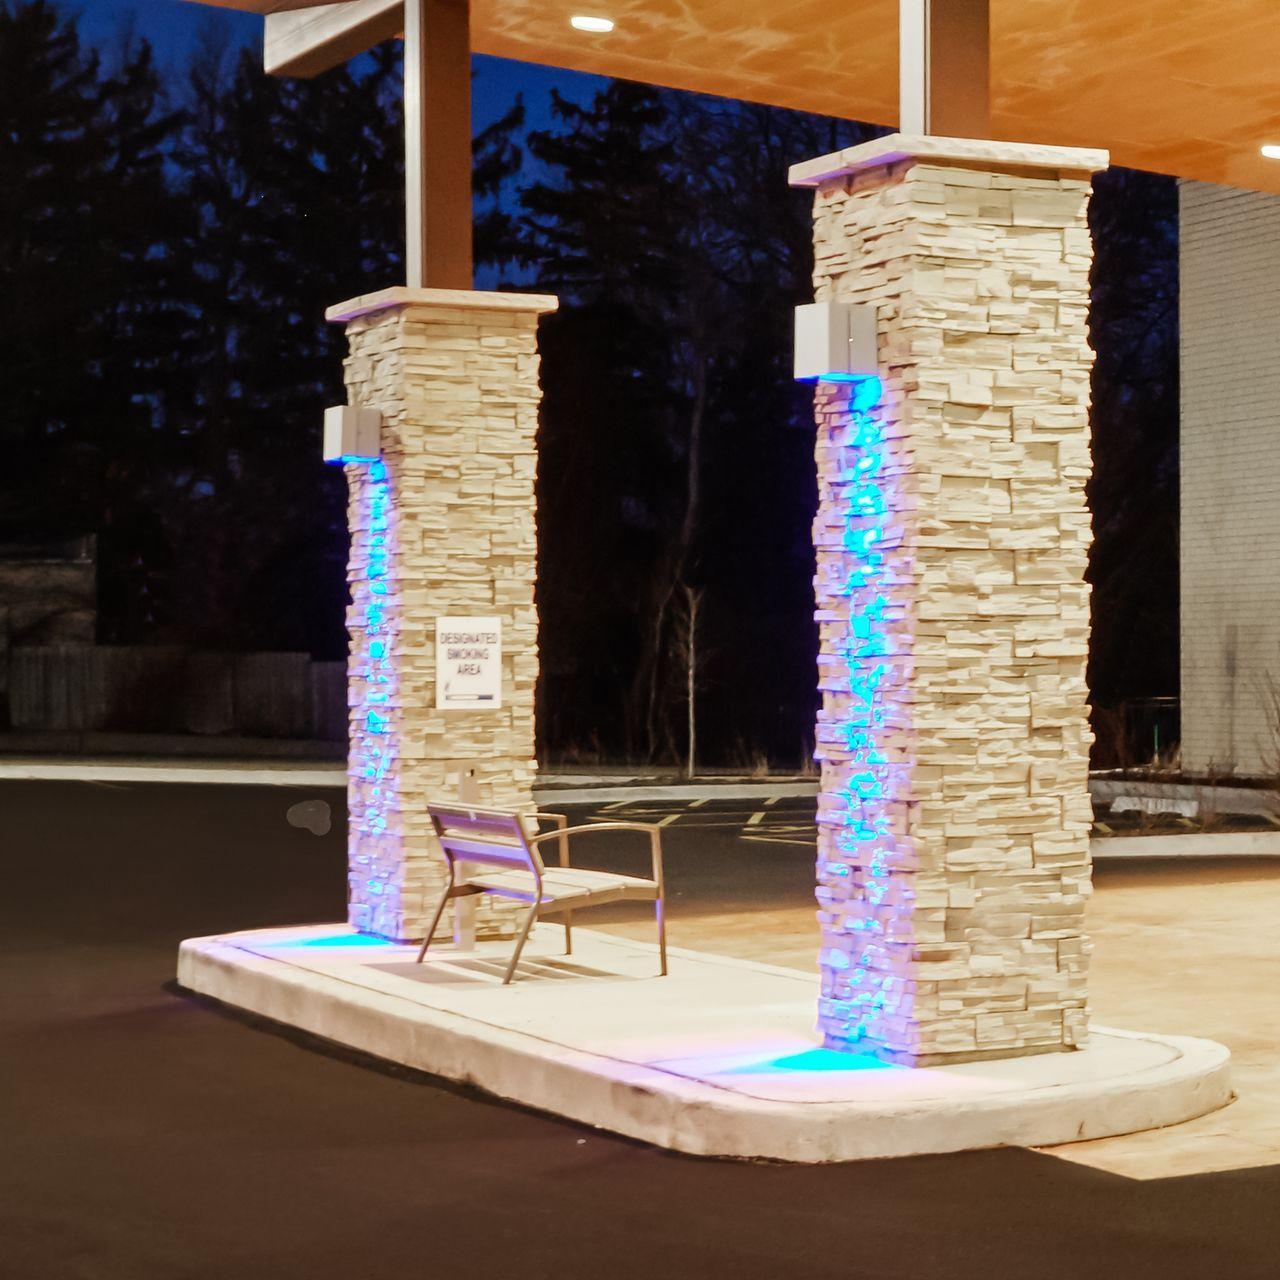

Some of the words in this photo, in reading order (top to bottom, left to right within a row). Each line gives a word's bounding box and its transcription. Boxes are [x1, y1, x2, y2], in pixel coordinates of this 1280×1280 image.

[440, 632, 497, 644] DESIGNATED
[447, 648, 489, 660] SMOKING
[457, 663, 482, 675] AREA
